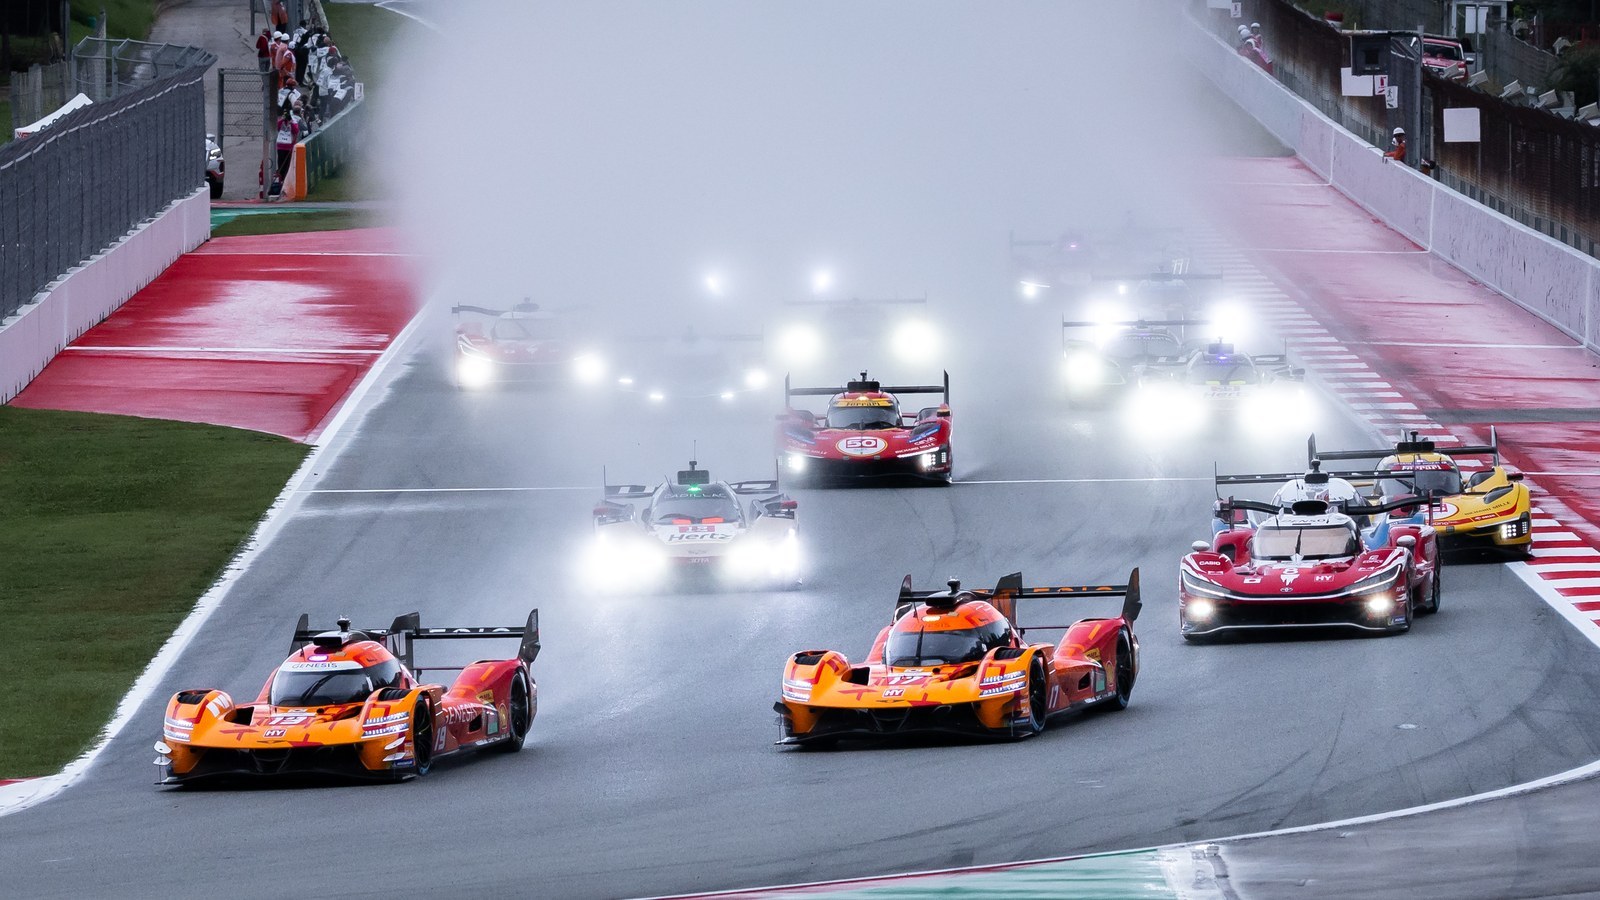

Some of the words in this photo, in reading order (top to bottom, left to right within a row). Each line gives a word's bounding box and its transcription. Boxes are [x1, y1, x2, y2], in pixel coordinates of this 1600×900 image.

[846, 439, 876, 448] 50
[914, 436, 936, 446] CEVA
[668, 532, 733, 541] Hertz
[889, 676, 926, 685] 17
[885, 689, 903, 697] HY
[269, 716, 308, 725] 19
[266, 729, 284, 737] HY
[434, 726, 447, 751] 19
